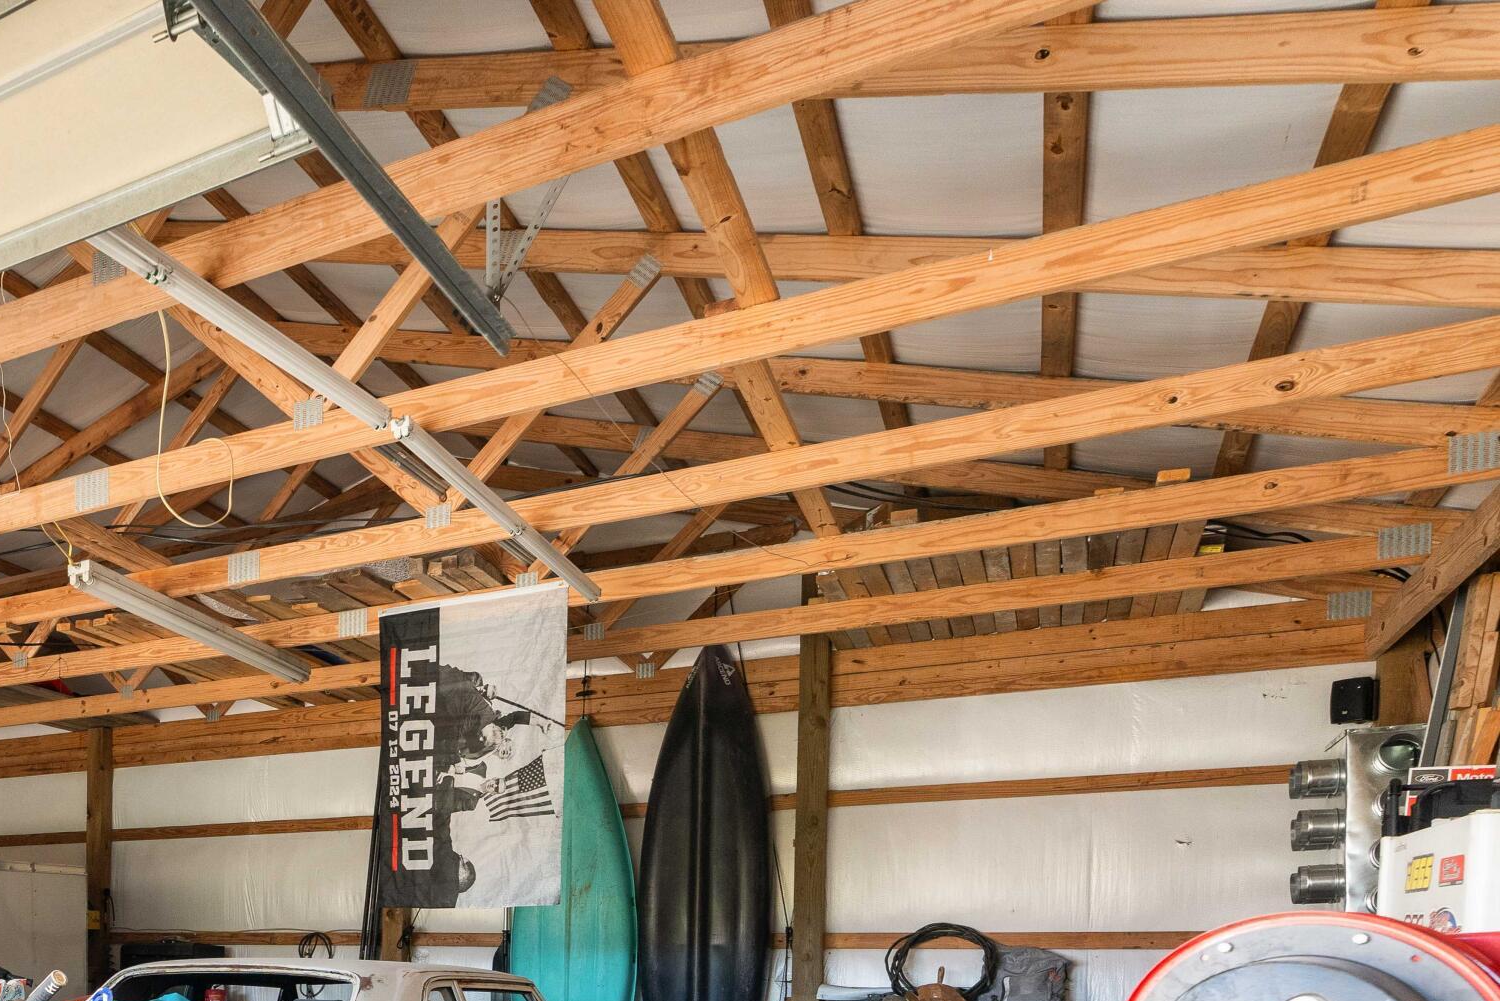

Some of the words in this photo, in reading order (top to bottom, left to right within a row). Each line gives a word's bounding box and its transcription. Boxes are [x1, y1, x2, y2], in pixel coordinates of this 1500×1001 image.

[388, 711, 399, 732] 07
[388, 740, 399, 758] 13
[399, 645, 437, 870] LEGEND
[388, 764, 400, 808] 2024
